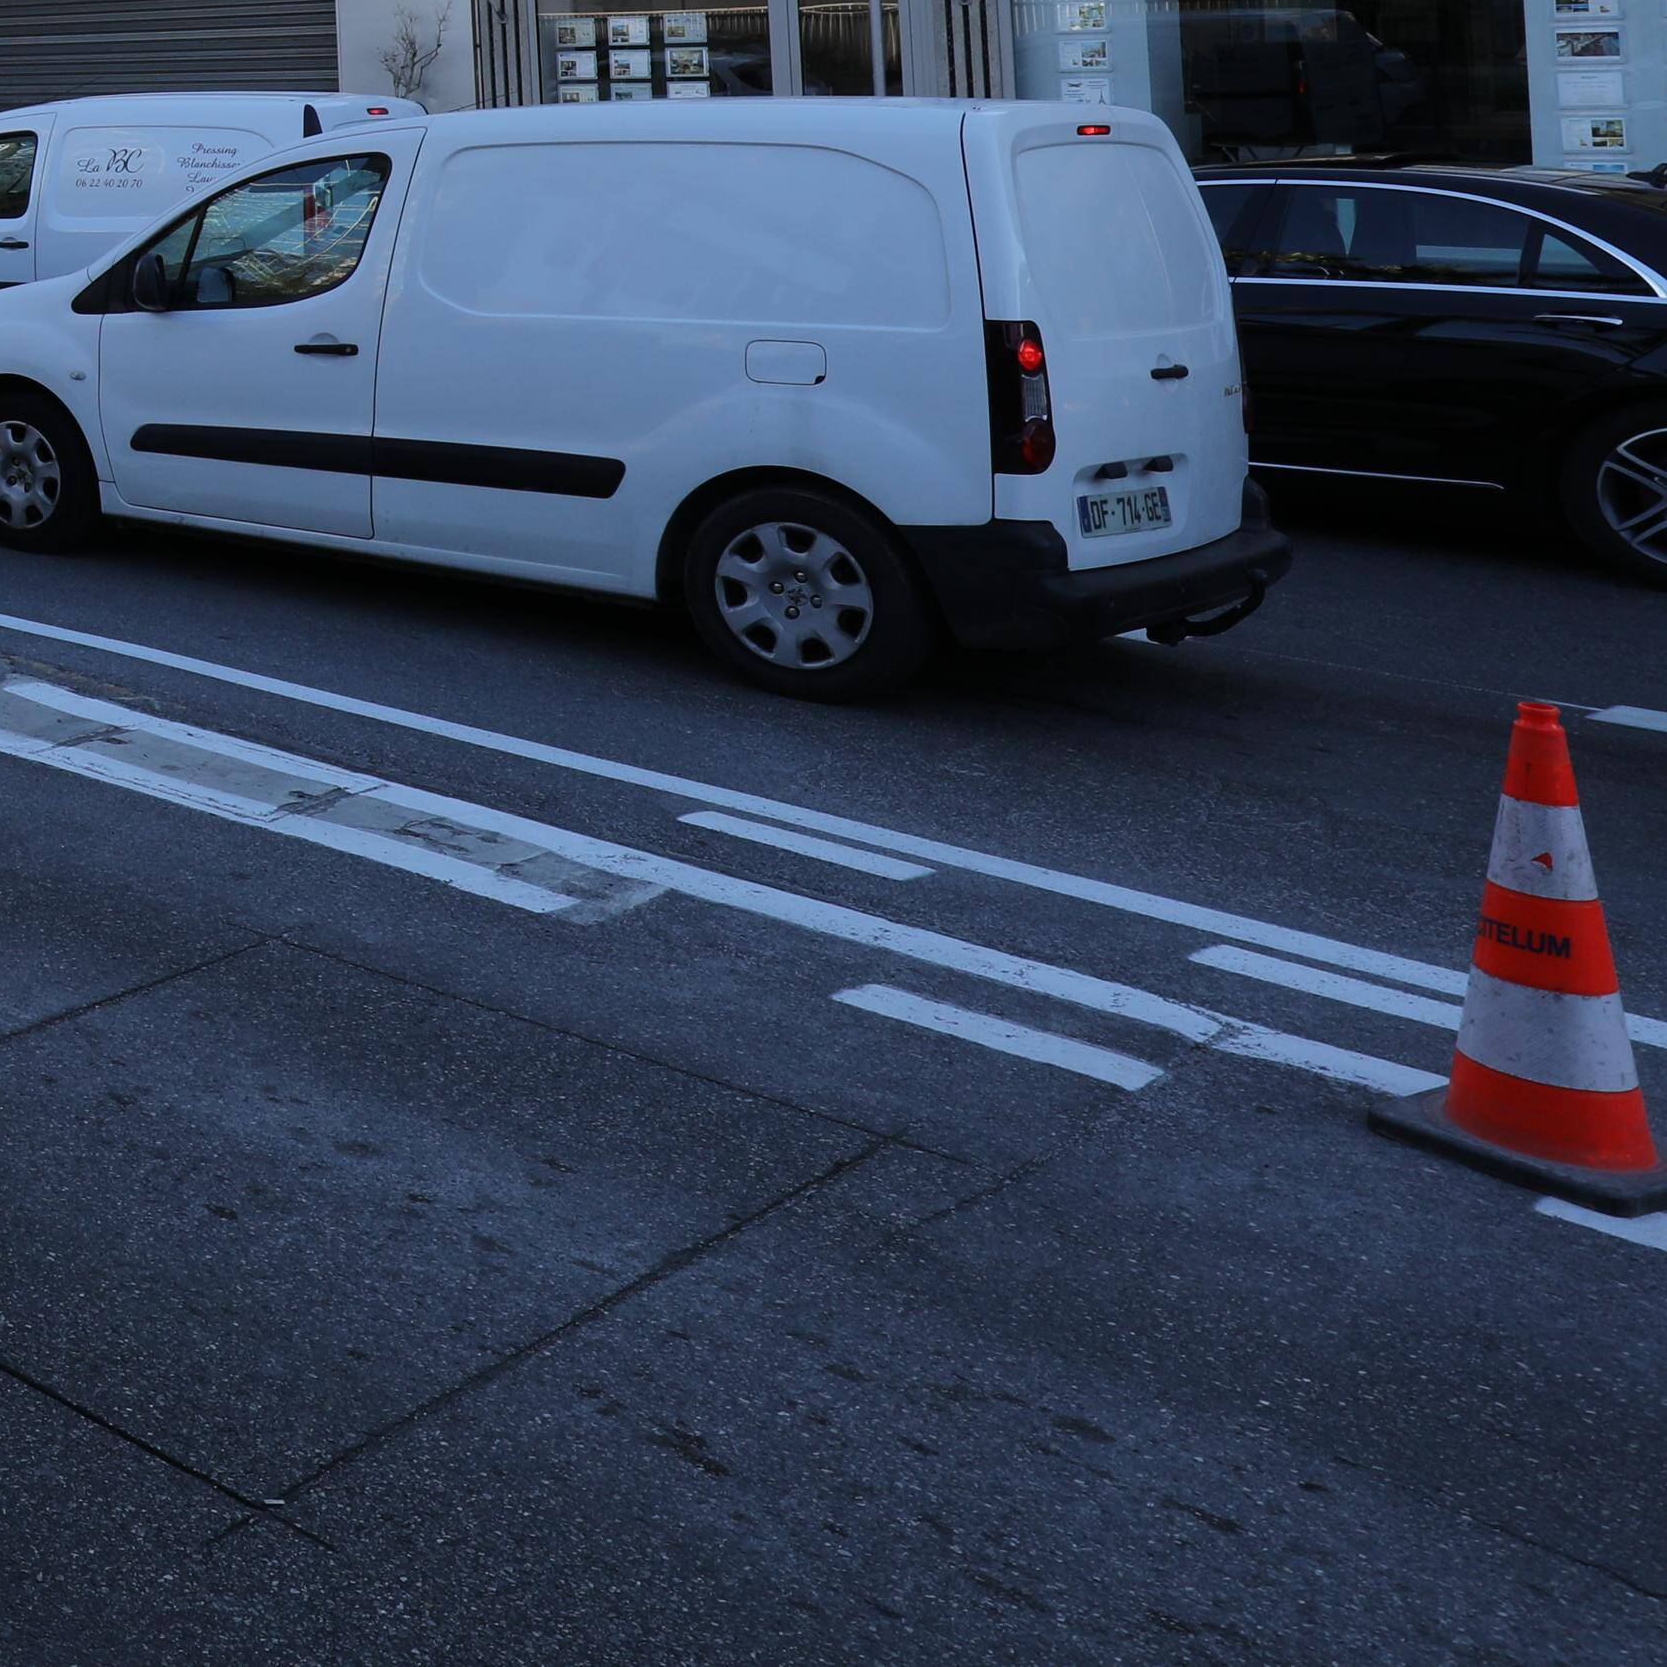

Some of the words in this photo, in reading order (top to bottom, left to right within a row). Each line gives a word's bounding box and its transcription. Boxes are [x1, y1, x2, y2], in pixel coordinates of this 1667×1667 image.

[191, 142, 238, 157] Pressing
[77, 158, 100, 173] La
[75, 178, 88, 188] 06
[89, 178, 101, 188] 22
[103, 178, 115, 188] 40
[117, 178, 129, 188] 20
[130, 178, 143, 188] 70
